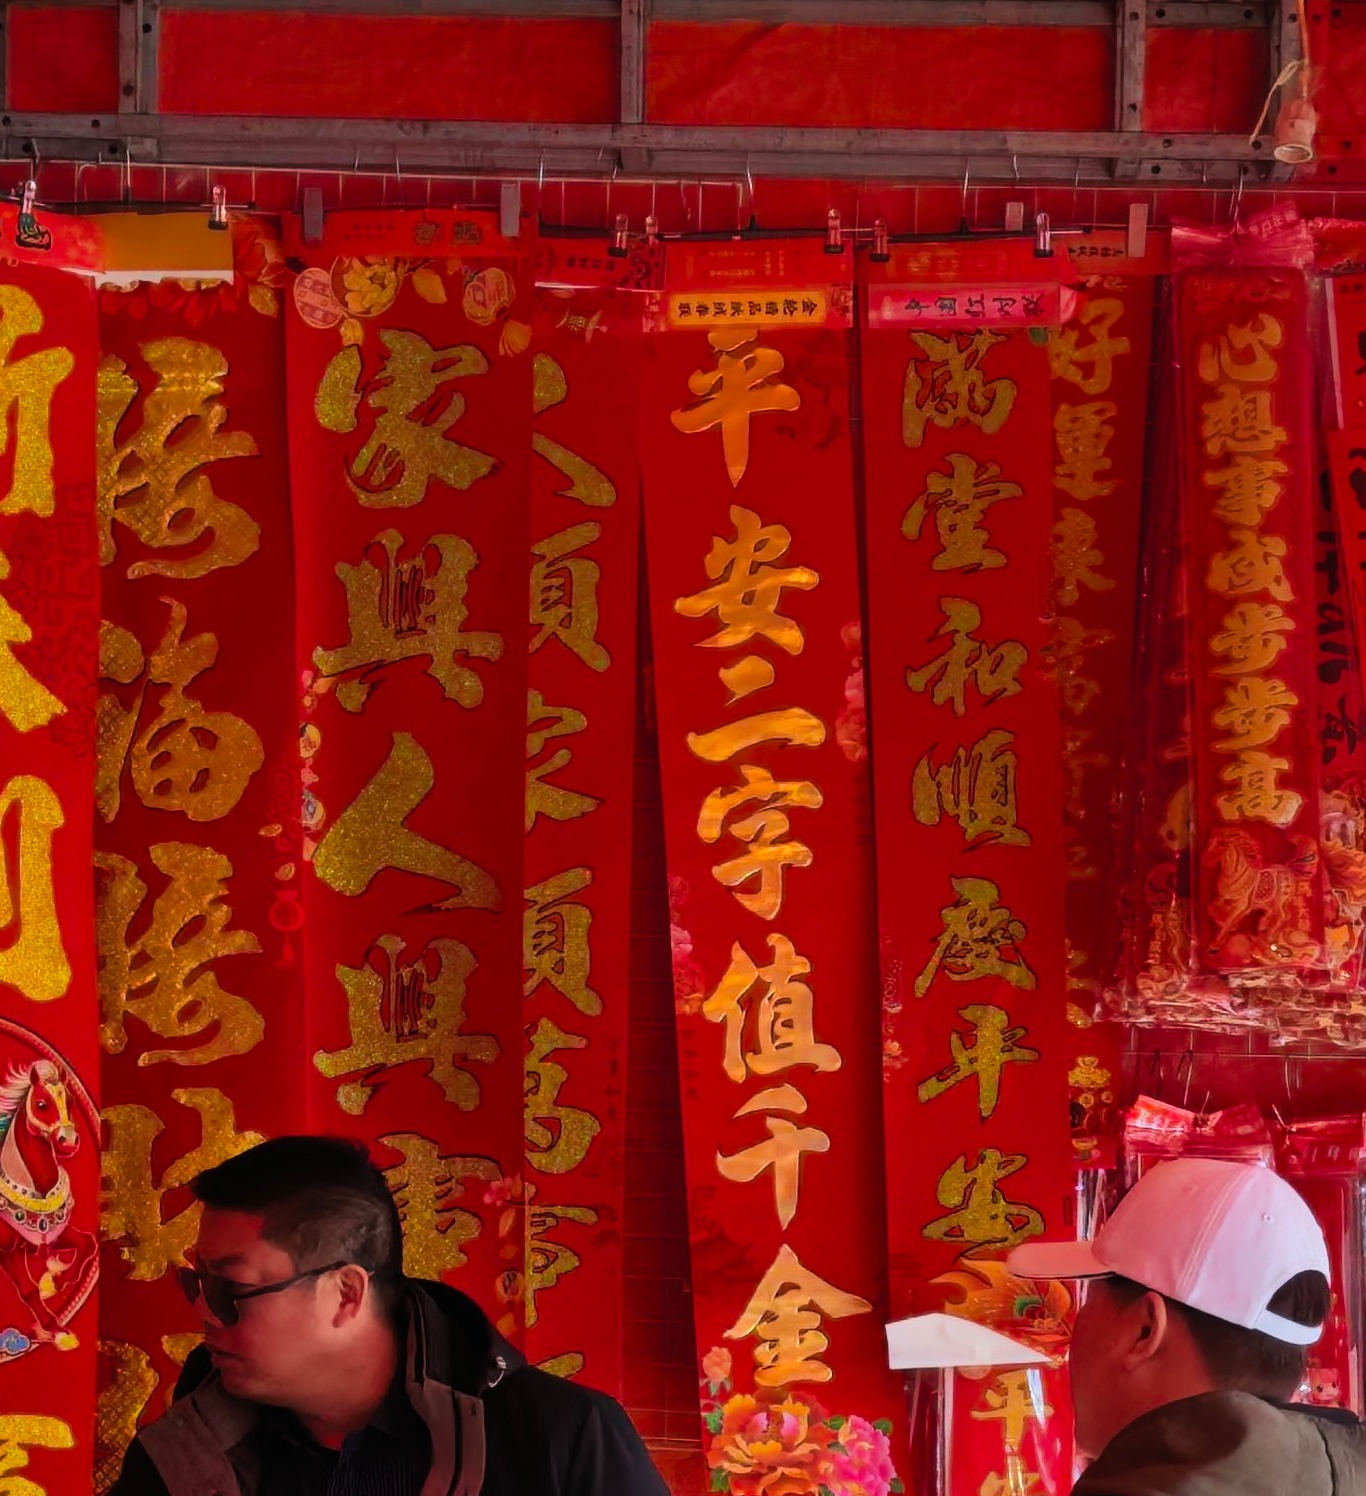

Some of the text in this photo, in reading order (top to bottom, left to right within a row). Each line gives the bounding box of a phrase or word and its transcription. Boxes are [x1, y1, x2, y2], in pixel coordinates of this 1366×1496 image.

[669, 326, 875, 1386] 平安二字值千金
[1198, 311, 1303, 828] 心想事成步步高
